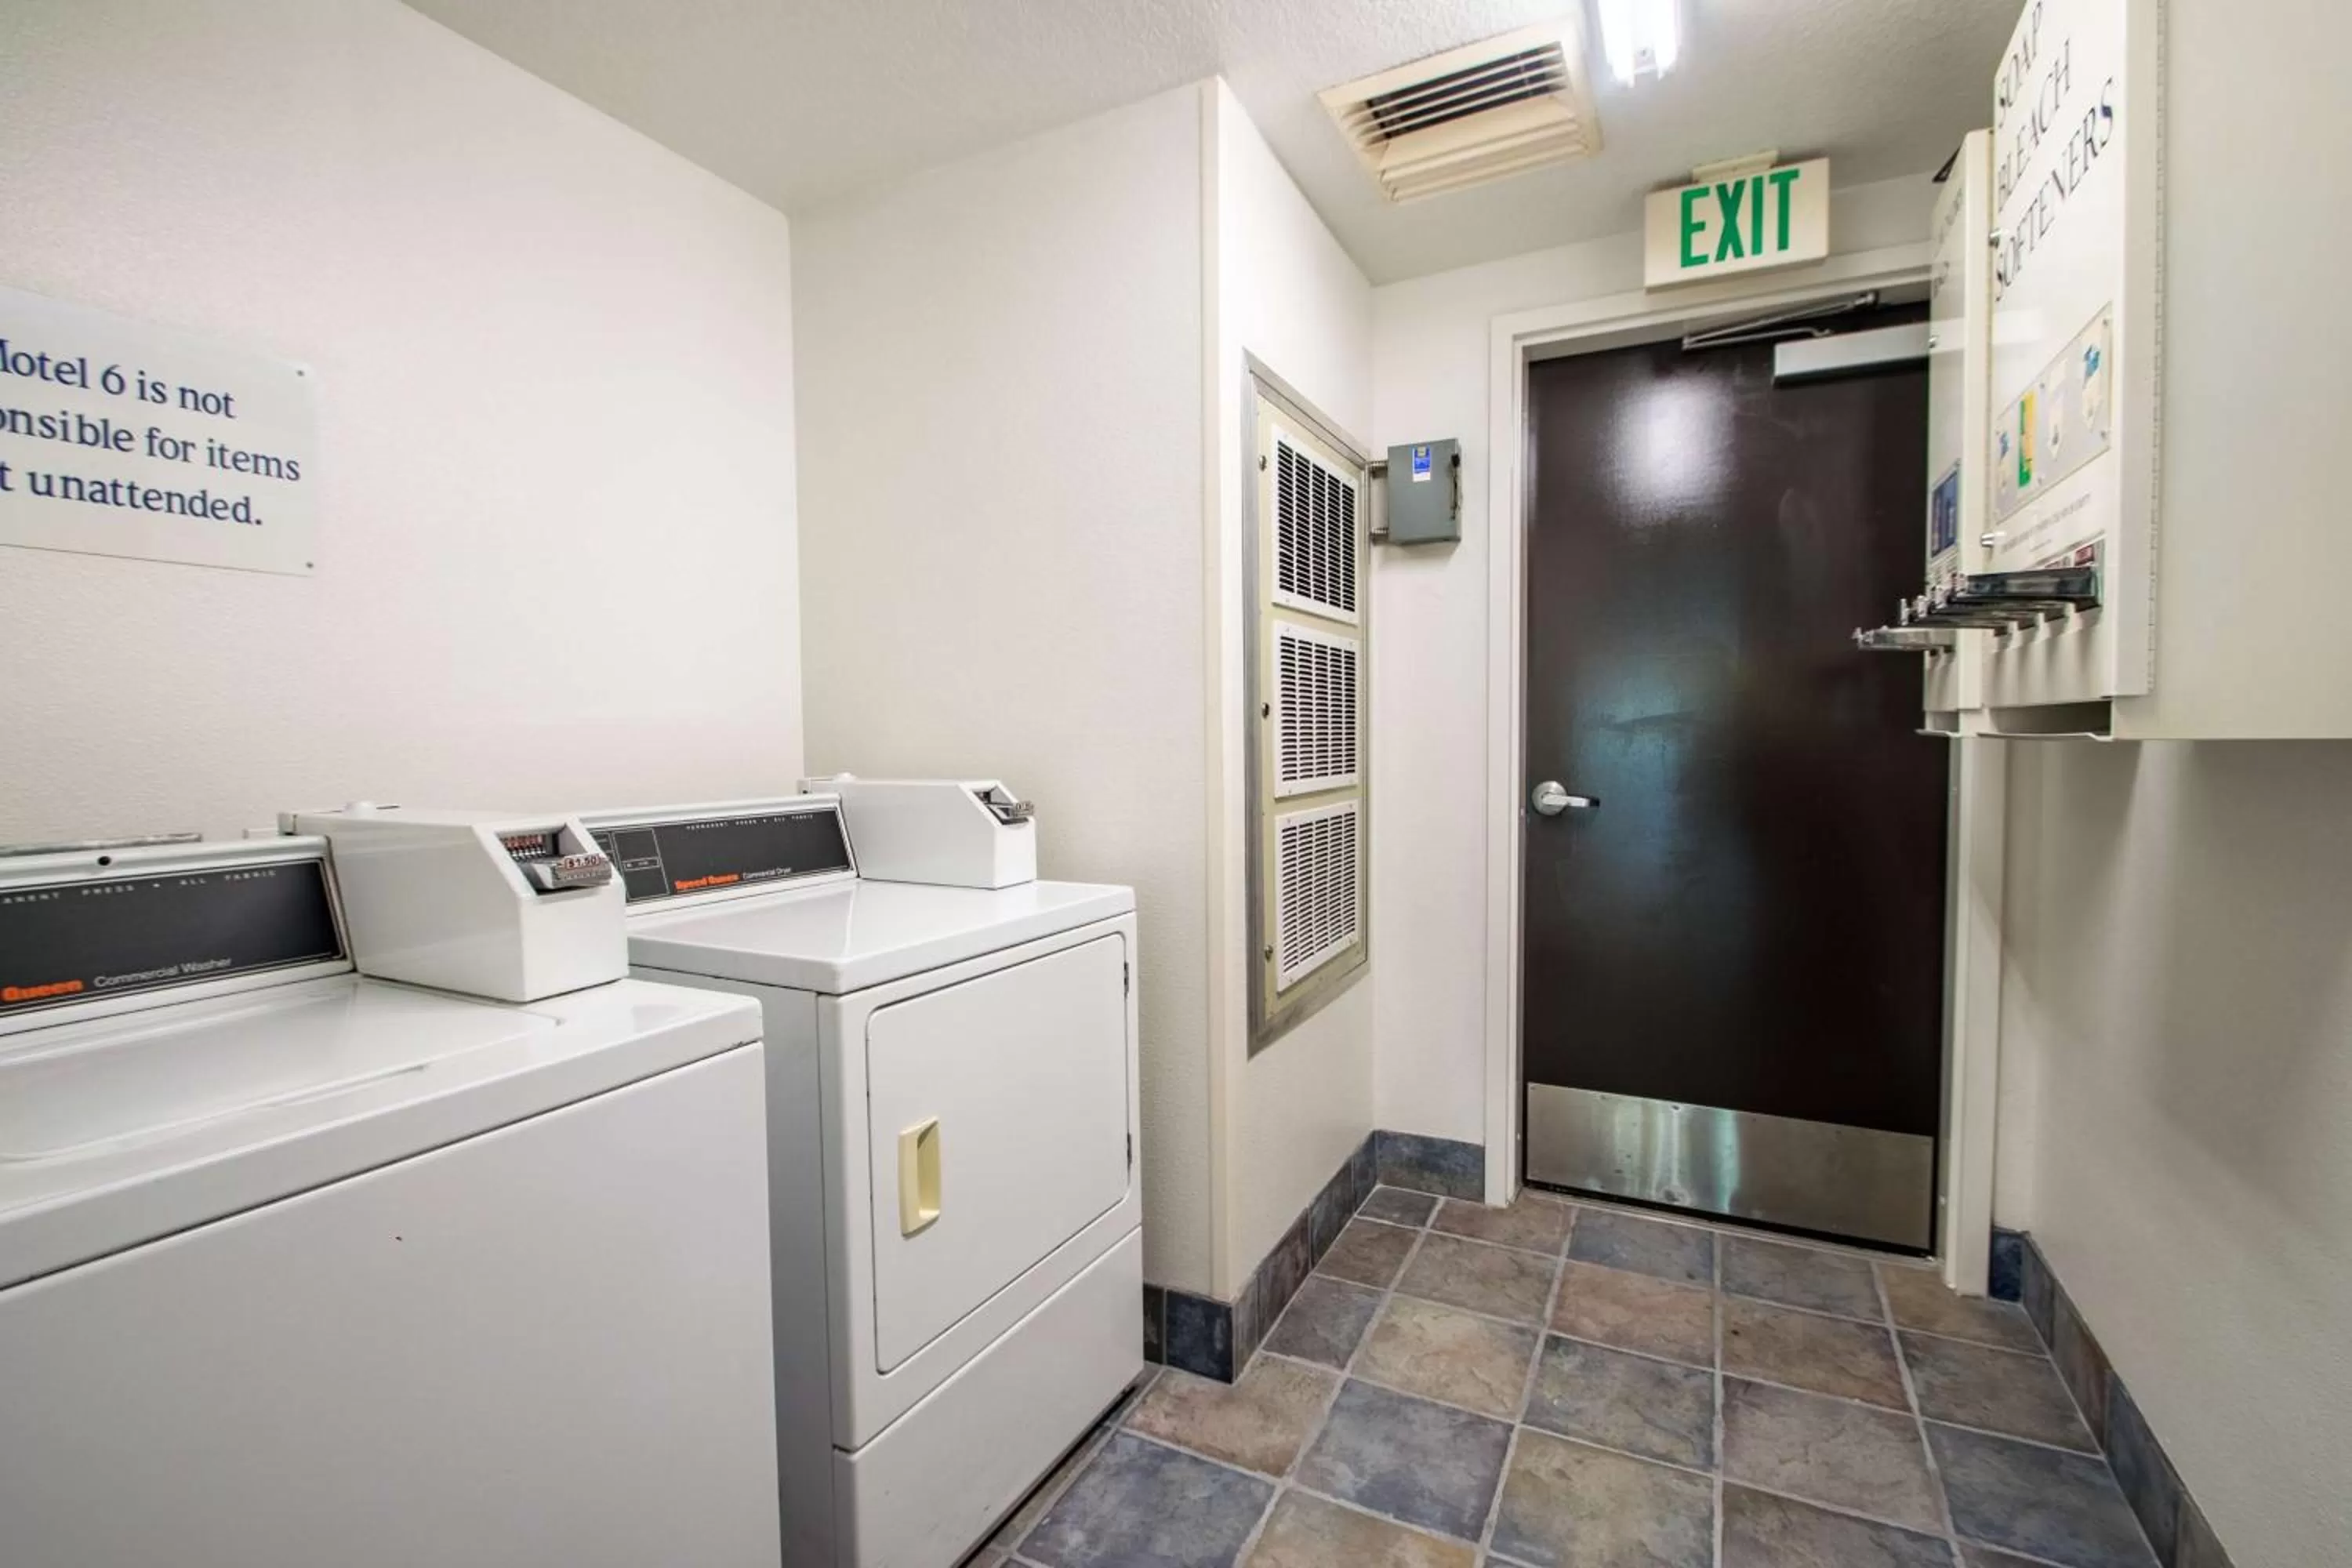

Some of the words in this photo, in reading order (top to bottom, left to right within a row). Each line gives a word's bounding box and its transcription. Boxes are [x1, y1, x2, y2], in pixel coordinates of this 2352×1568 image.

[1998, 37, 2071, 213] BLEACH
[1680, 168, 1801, 269] EXIT
[1994, 76, 2114, 303] SOFTENERS
[101, 364, 126, 396] 6
[137, 370, 168, 405] is
[179, 387, 238, 419] not
[0, 408, 135, 452] nsible
[145, 426, 197, 463] for
[207, 438, 301, 481] items
[28, 471, 263, 526] unattended.
[2, 979, 84, 1002] Queen
[93, 964, 180, 989] Commercial
[180, 956, 232, 976] Washer
